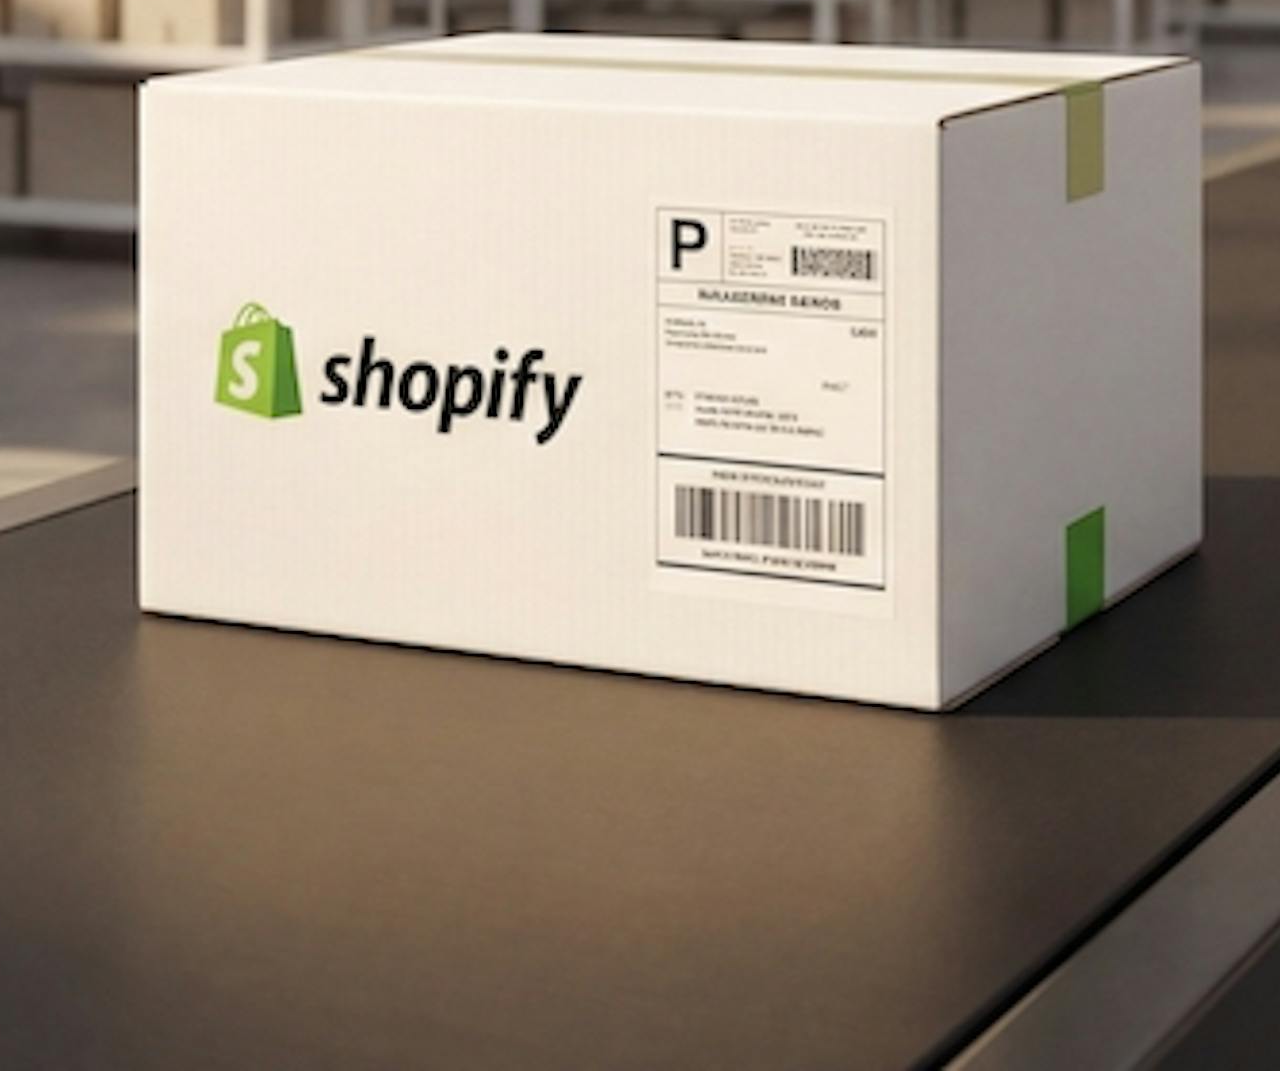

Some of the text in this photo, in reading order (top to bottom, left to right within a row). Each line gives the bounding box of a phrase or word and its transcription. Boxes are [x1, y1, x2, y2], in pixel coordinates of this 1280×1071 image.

[671, 218, 708, 270] P
[228, 339, 262, 401] S
[320, 335, 582, 444] shopify
